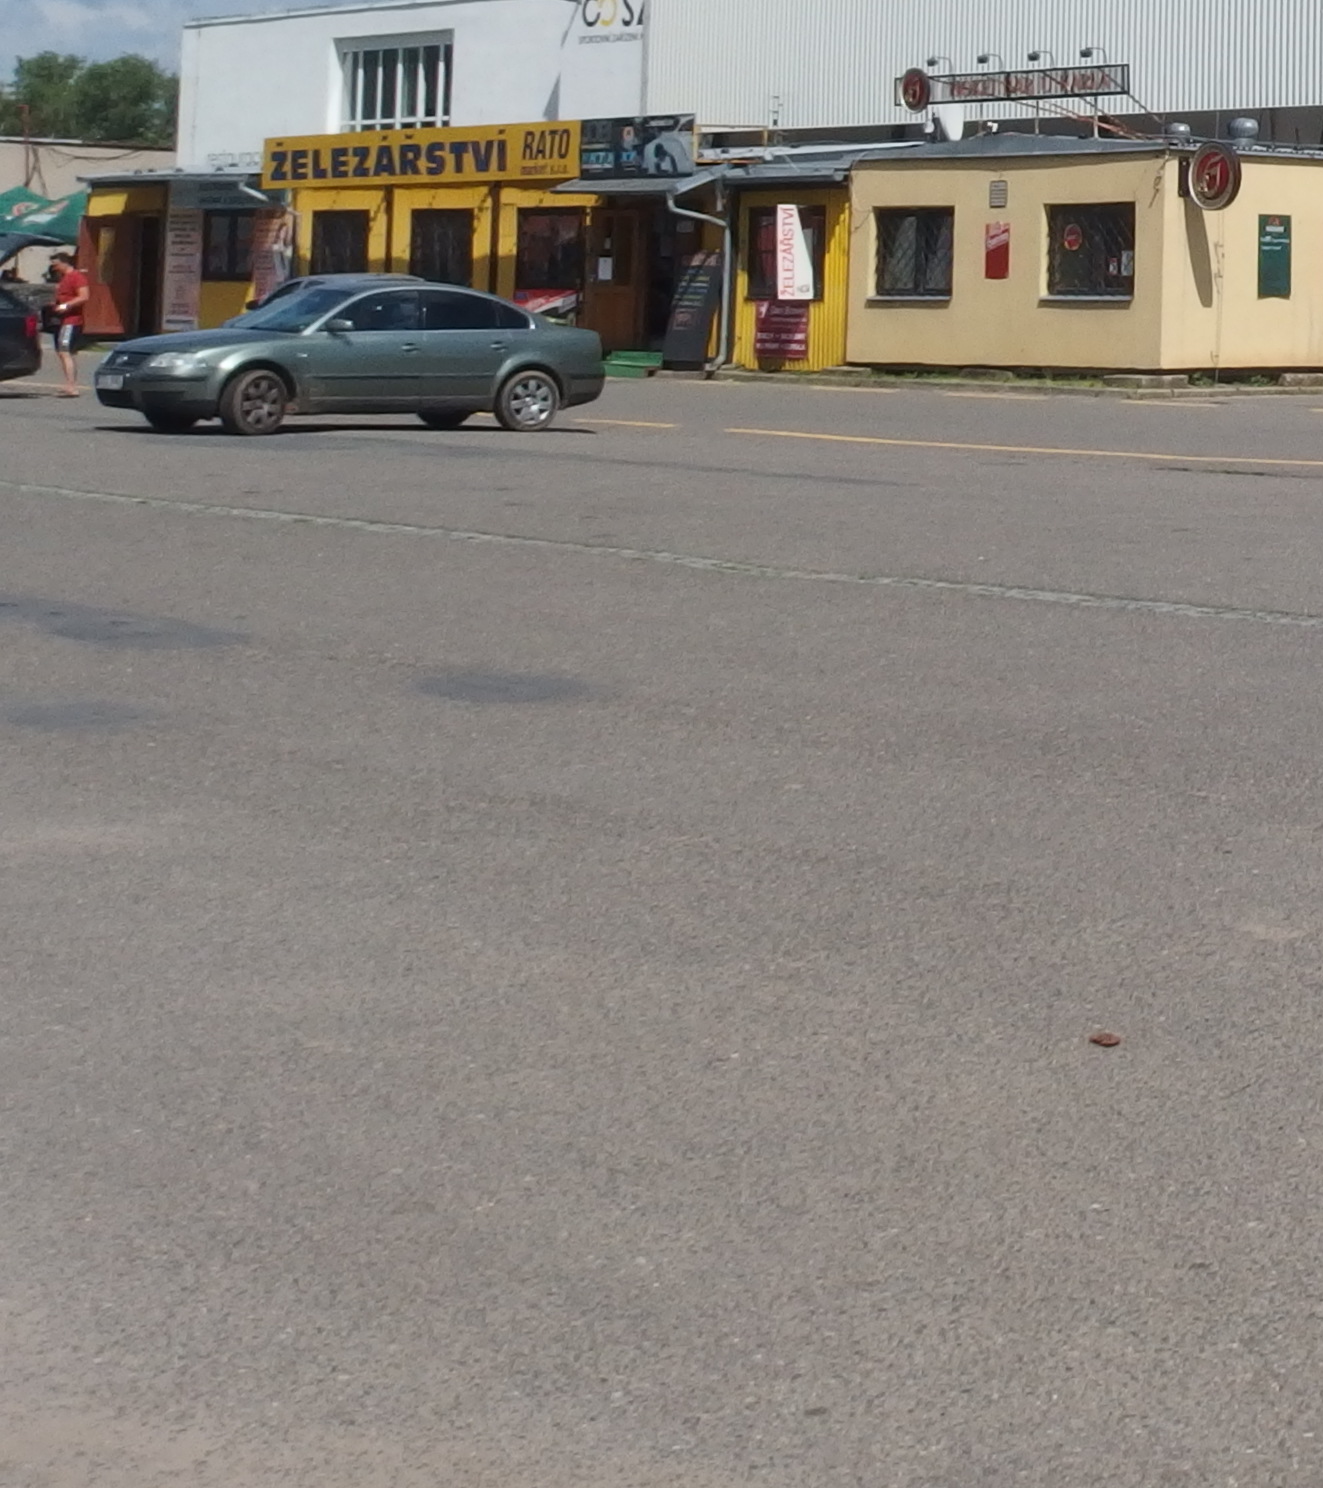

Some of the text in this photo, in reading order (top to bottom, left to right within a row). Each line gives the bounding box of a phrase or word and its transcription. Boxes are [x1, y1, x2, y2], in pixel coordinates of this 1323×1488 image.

[270, 129, 508, 181] ŽELEZÁŘSTVÍ
[522, 128, 570, 161] RATO
[780, 206, 796, 297] ŽELEZÁŘSTVÍ
